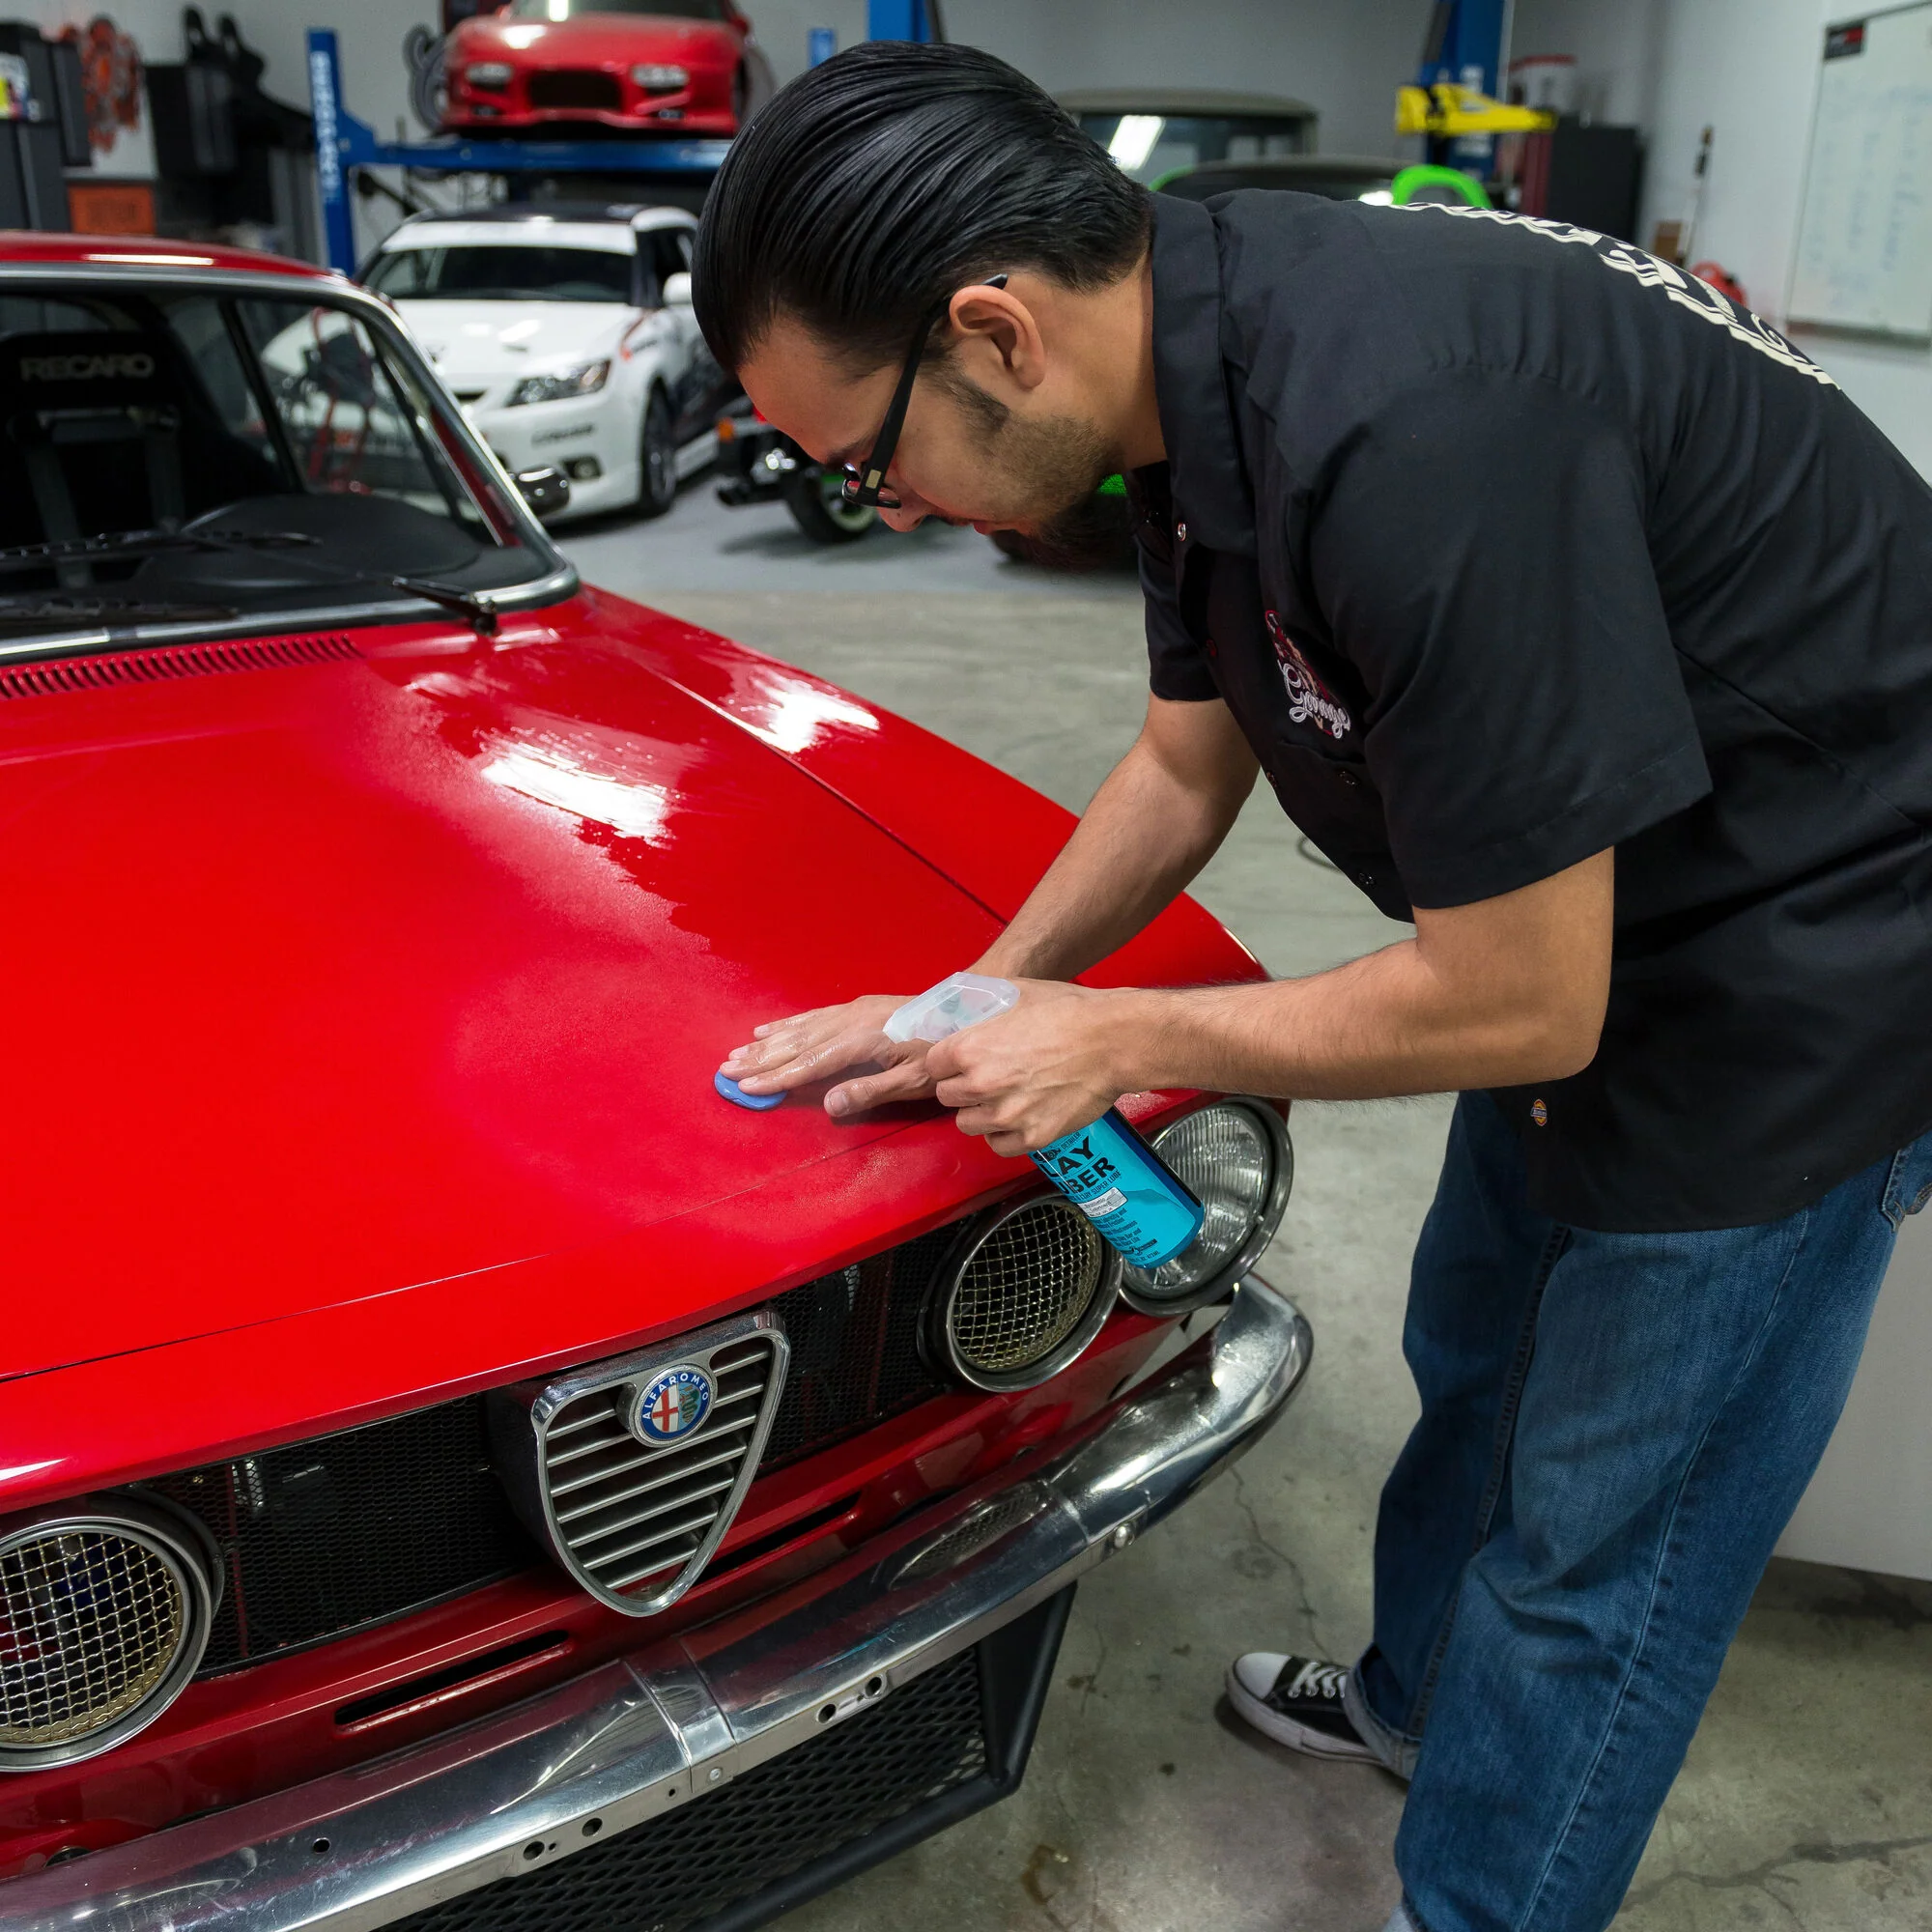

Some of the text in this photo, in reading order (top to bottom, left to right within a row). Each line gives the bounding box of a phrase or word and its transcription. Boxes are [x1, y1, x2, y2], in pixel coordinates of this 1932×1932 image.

[20, 353, 156, 382] RECARO
[1092, 1180, 1109, 1194] SUPER
[1108, 1169, 1121, 1183] LUBE
